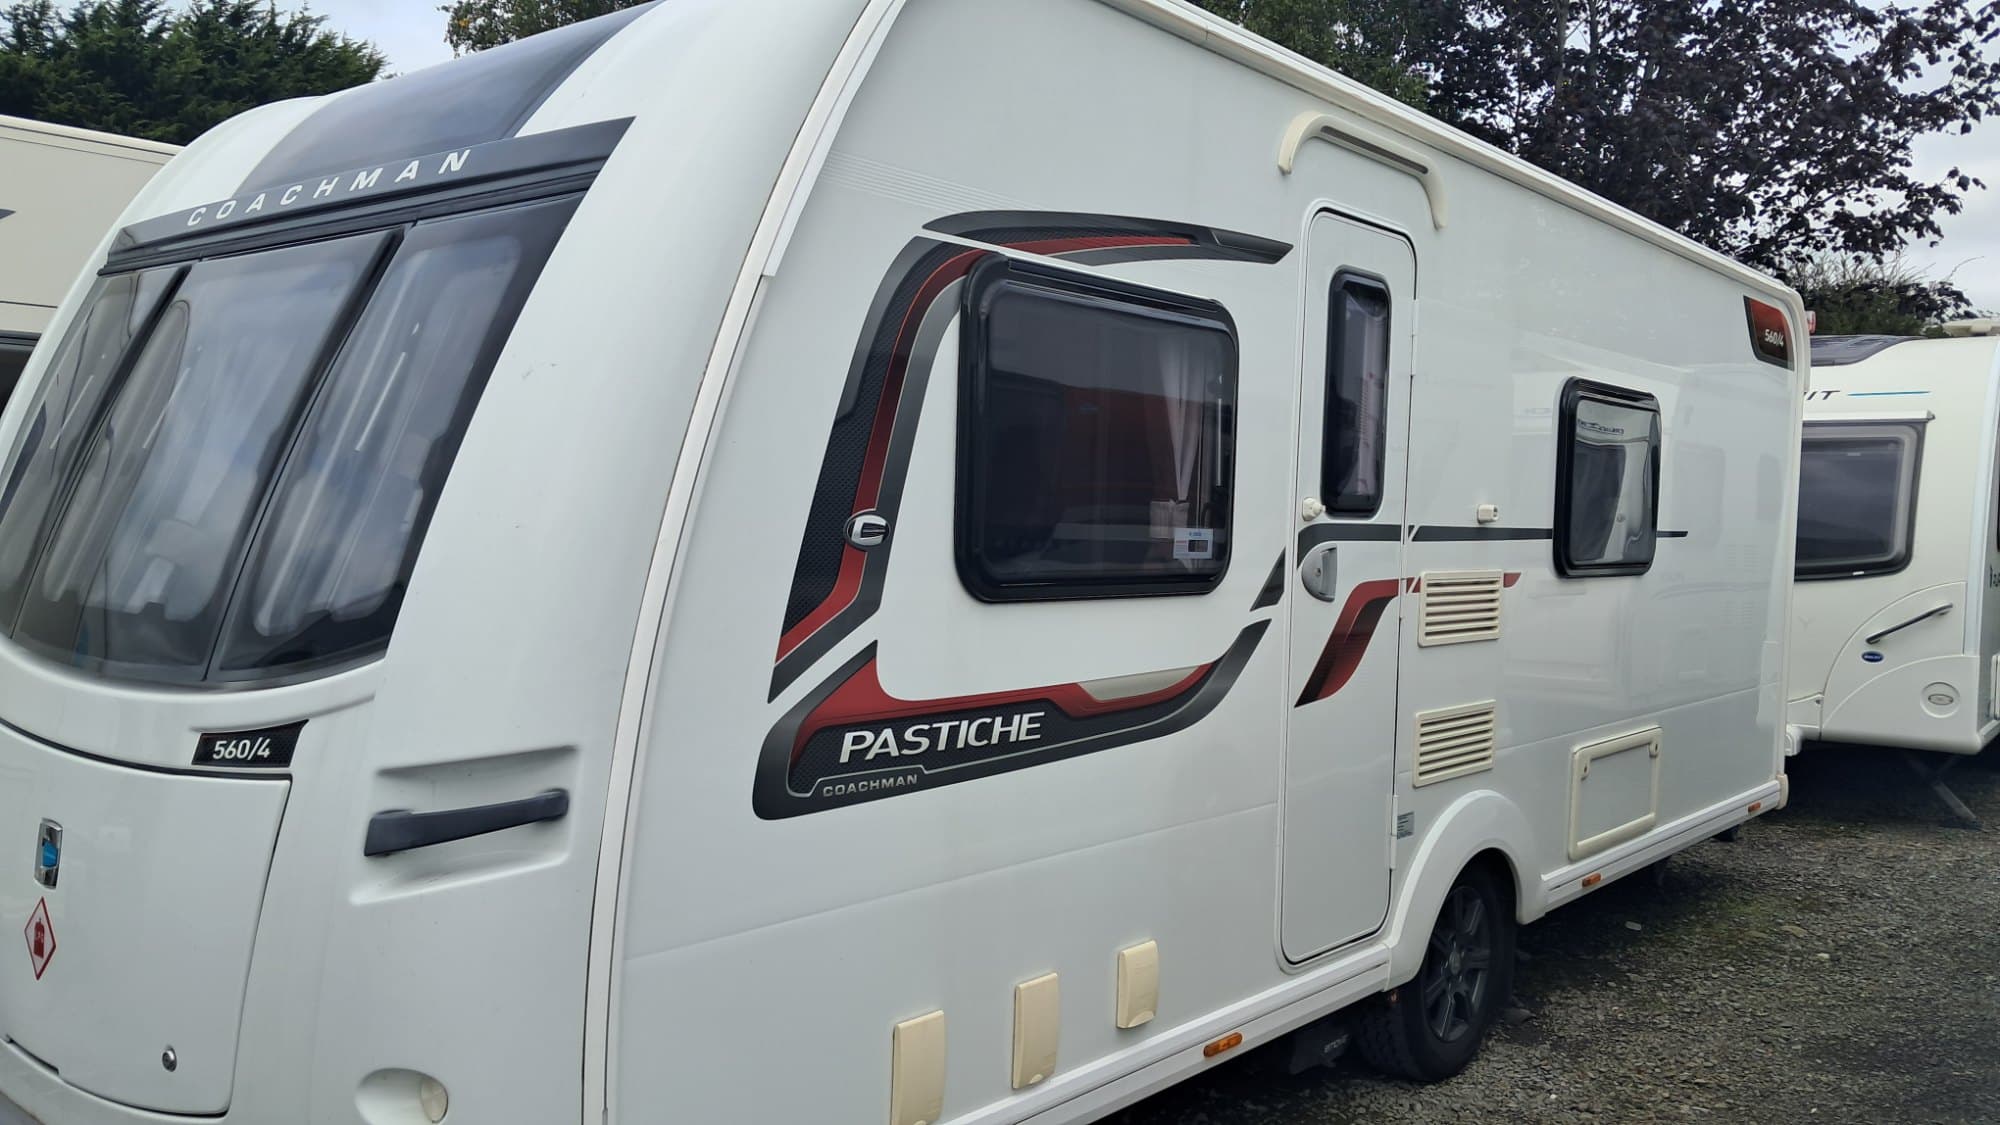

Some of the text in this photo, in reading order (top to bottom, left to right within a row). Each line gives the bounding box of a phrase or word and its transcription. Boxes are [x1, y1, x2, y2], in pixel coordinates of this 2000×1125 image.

[187, 149, 473, 227] COACHMAN
[1803, 390, 1841, 401] IT
[212, 737, 271, 760] 560/4
[838, 711, 1045, 764] PASTICHE
[822, 775, 918, 798] COACHMAN
